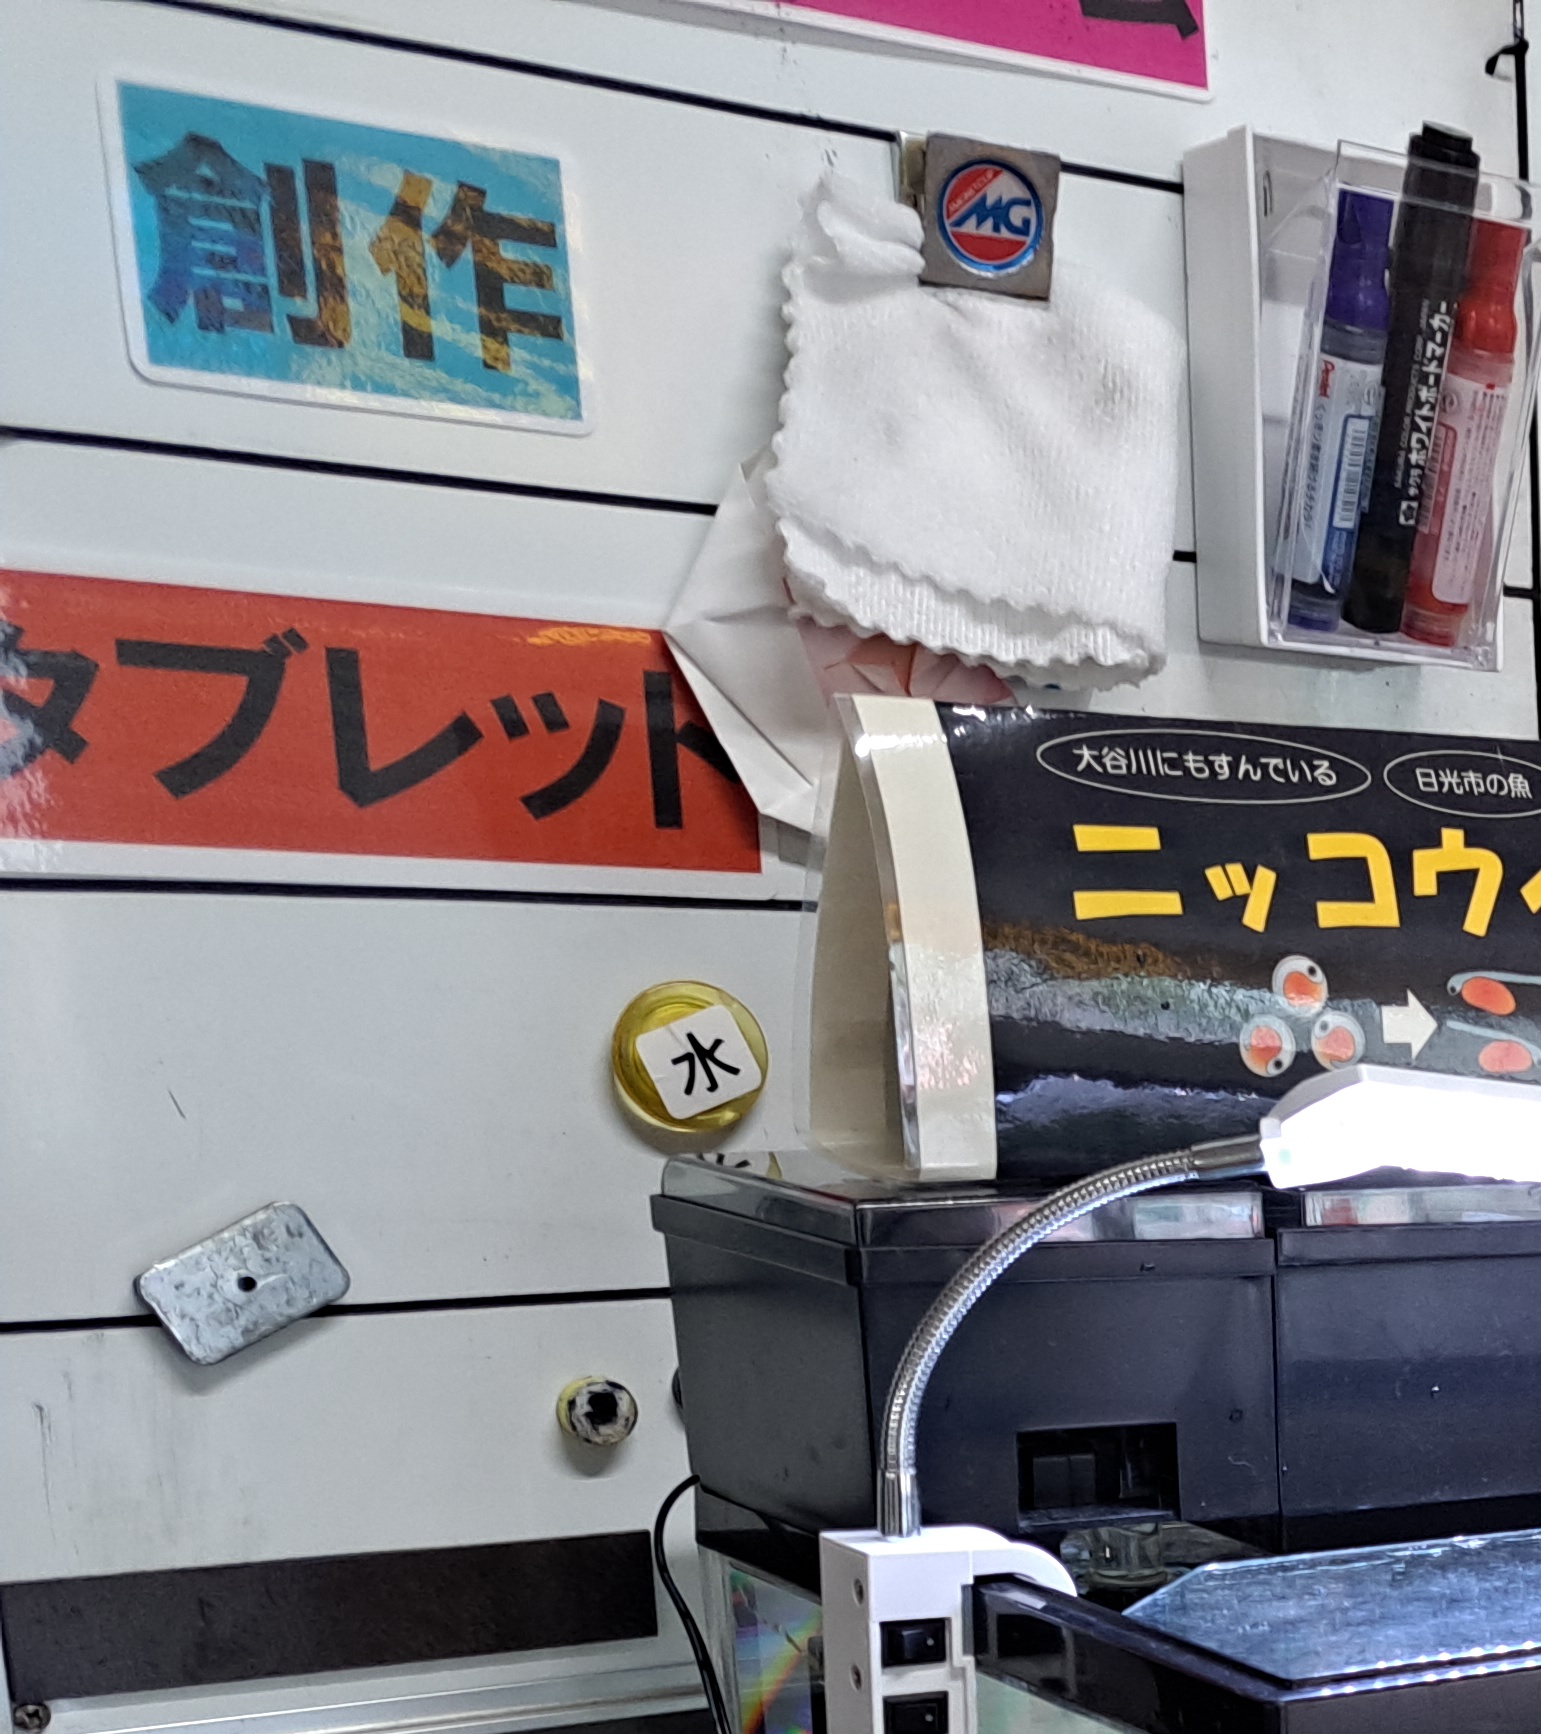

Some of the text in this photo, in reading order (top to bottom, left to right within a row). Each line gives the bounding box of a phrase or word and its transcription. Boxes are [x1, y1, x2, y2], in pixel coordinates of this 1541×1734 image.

[134, 131, 565, 374] 創作
[1408, 300, 1452, 466] ホワイトボードマーカー
[0, 617, 745, 831] タブレット
[1072, 743, 1338, 787] 大谷川にもすんでいる
[1415, 767, 1533, 800] 日光市の魚
[671, 1031, 741, 1095] 水
